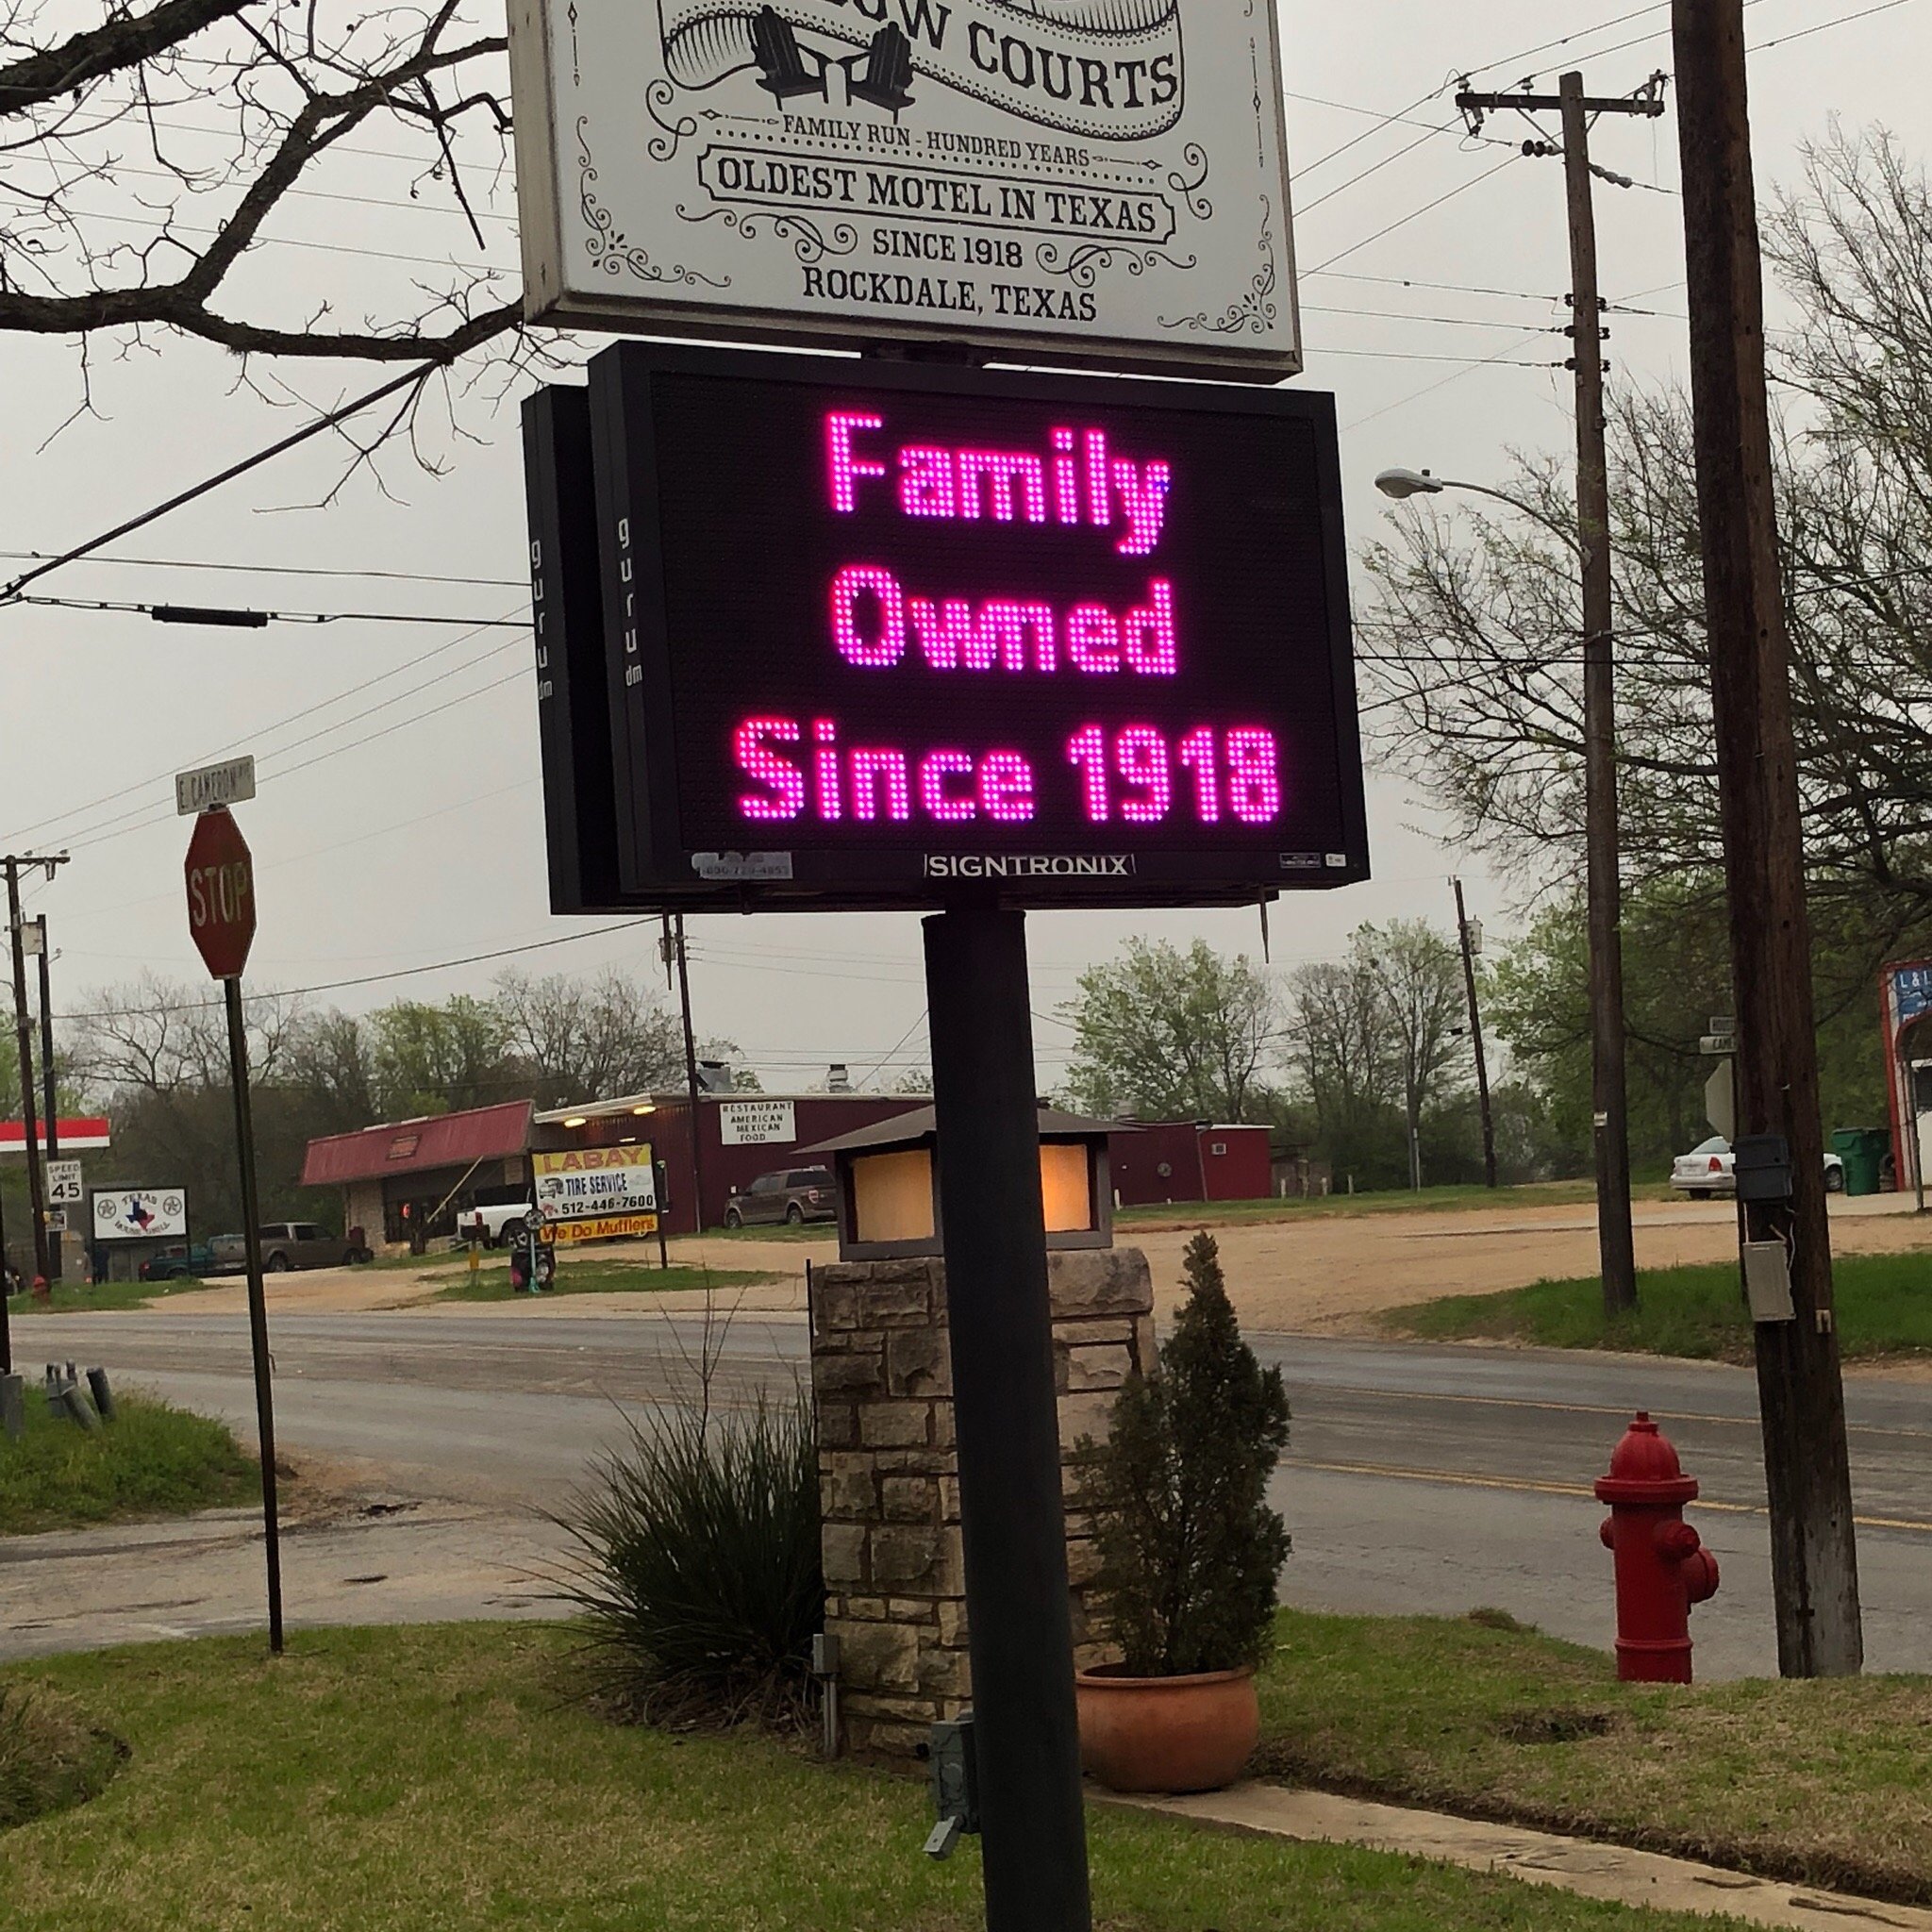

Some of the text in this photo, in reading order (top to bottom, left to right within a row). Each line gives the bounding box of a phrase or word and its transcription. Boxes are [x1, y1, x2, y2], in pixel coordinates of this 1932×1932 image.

[968, 21, 1178, 108] COURTS
[782, 114, 862, 142] FAMILY
[867, 125, 910, 146] RUN
[927, 131, 1021, 159] HUNDRED
[1026, 142, 1090, 167] YEARS
[717, 156, 1157, 233] OLDEST MOTEL IN TEXAS
[873, 228, 1024, 268] SINCE 1918
[803, 266, 1097, 323] ROCKDALE, TEXAS
[824, 409, 1171, 557] Family
[830, 566, 1179, 677] Owned
[732, 717, 1283, 825] Since 1918
[929, 855, 1129, 877] SIGNTRONIX
[191, 862, 247, 926] STOP
[723, 1102, 792, 1112] RESTAURANT
[731, 1114, 783, 1124] AMERICAN
[737, 1124, 780, 1132] MEXICAN
[48, 1164, 79, 1174] SPEED
[543, 1147, 642, 1173] LABAY
[51, 1182, 80, 1198] 45
[53, 1174, 76, 1182] LIMIT
[566, 1173, 627, 1196] TIRE SERVICE
[562, 1194, 654, 1214] 512-446-7600
[543, 1218, 655, 1240] We Do Mufflers
